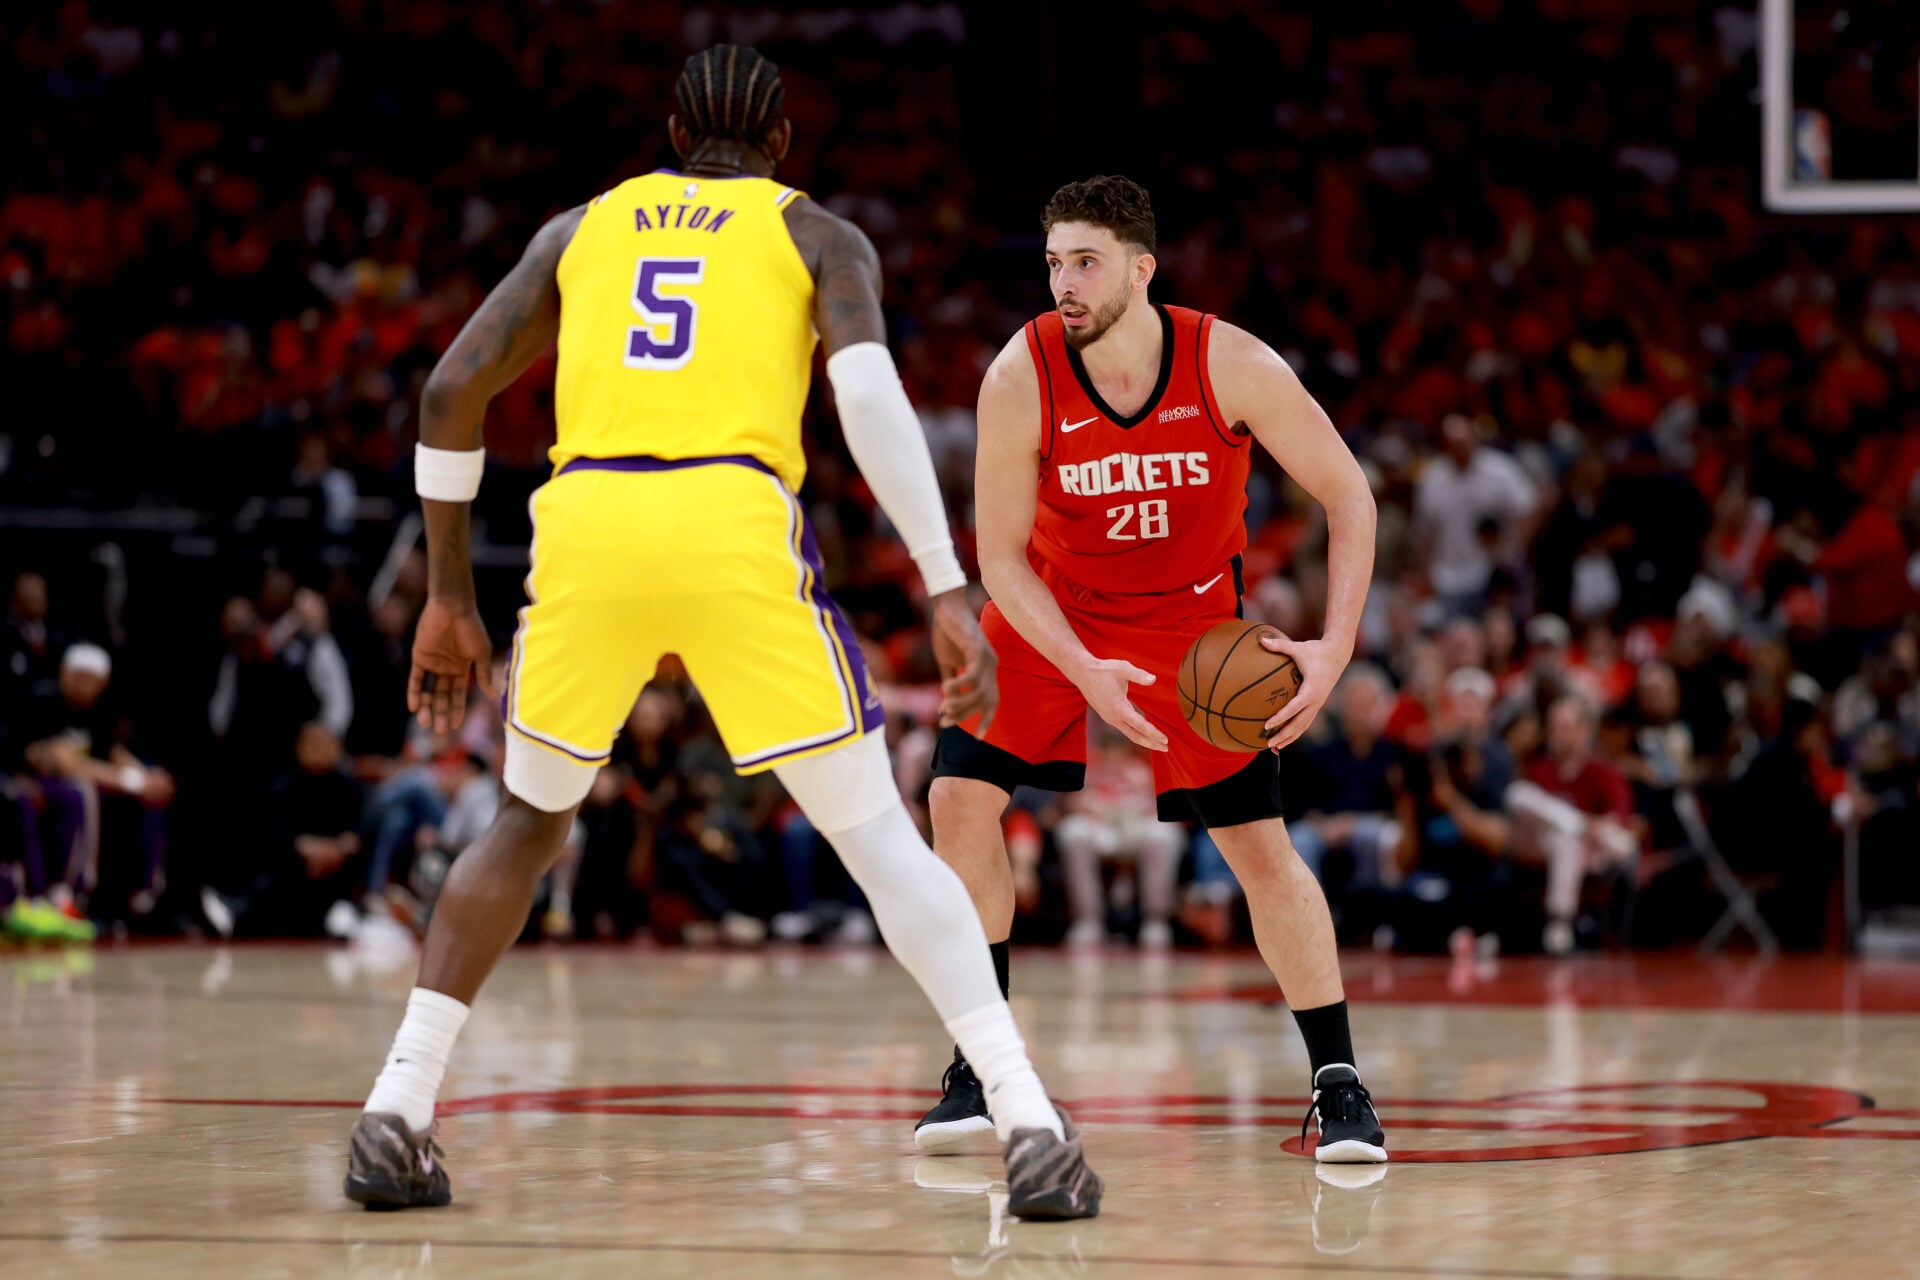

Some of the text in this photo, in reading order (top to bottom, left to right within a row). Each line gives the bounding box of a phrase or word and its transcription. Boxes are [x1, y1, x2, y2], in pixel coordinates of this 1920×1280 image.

[635, 204, 735, 233] AYTON
[623, 256, 706, 371] 5
[1158, 404, 1199, 418] MEMORIAL
[1158, 408, 1200, 424] HERMANN
[1058, 452, 1210, 496] ROCKETS
[1106, 499, 1170, 541] 28
